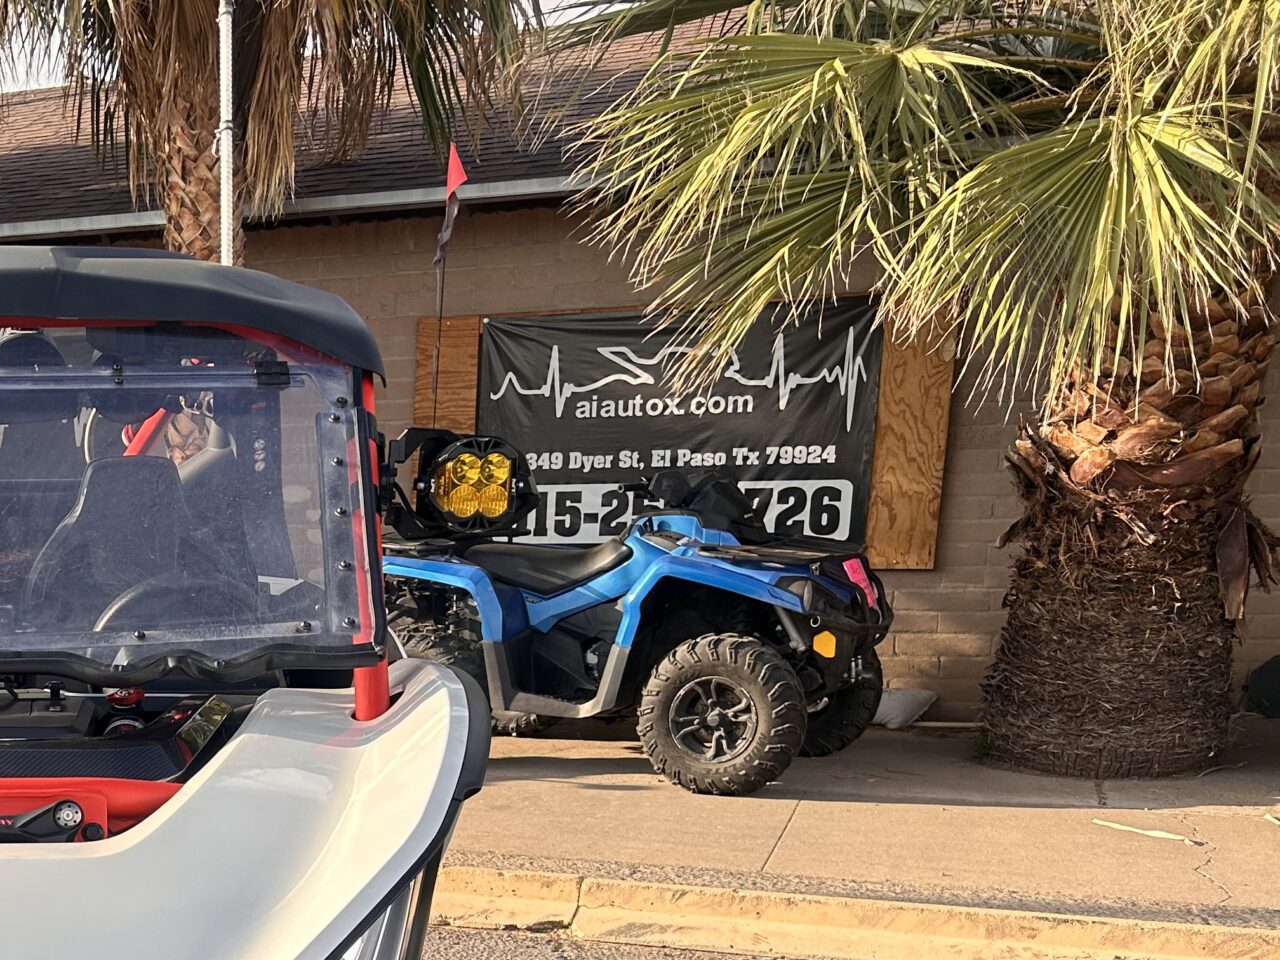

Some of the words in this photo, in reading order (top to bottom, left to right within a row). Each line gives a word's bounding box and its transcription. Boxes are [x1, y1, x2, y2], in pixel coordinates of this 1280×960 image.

[575, 394, 754, 418] aiautox.com
[568, 451, 614, 473] Dyer
[618, 450, 645, 470] St,
[650, 449, 671, 468] El
[676, 448, 727, 467] Paso
[732, 447, 760, 466] Tx
[765, 444, 837, 465] 79924
